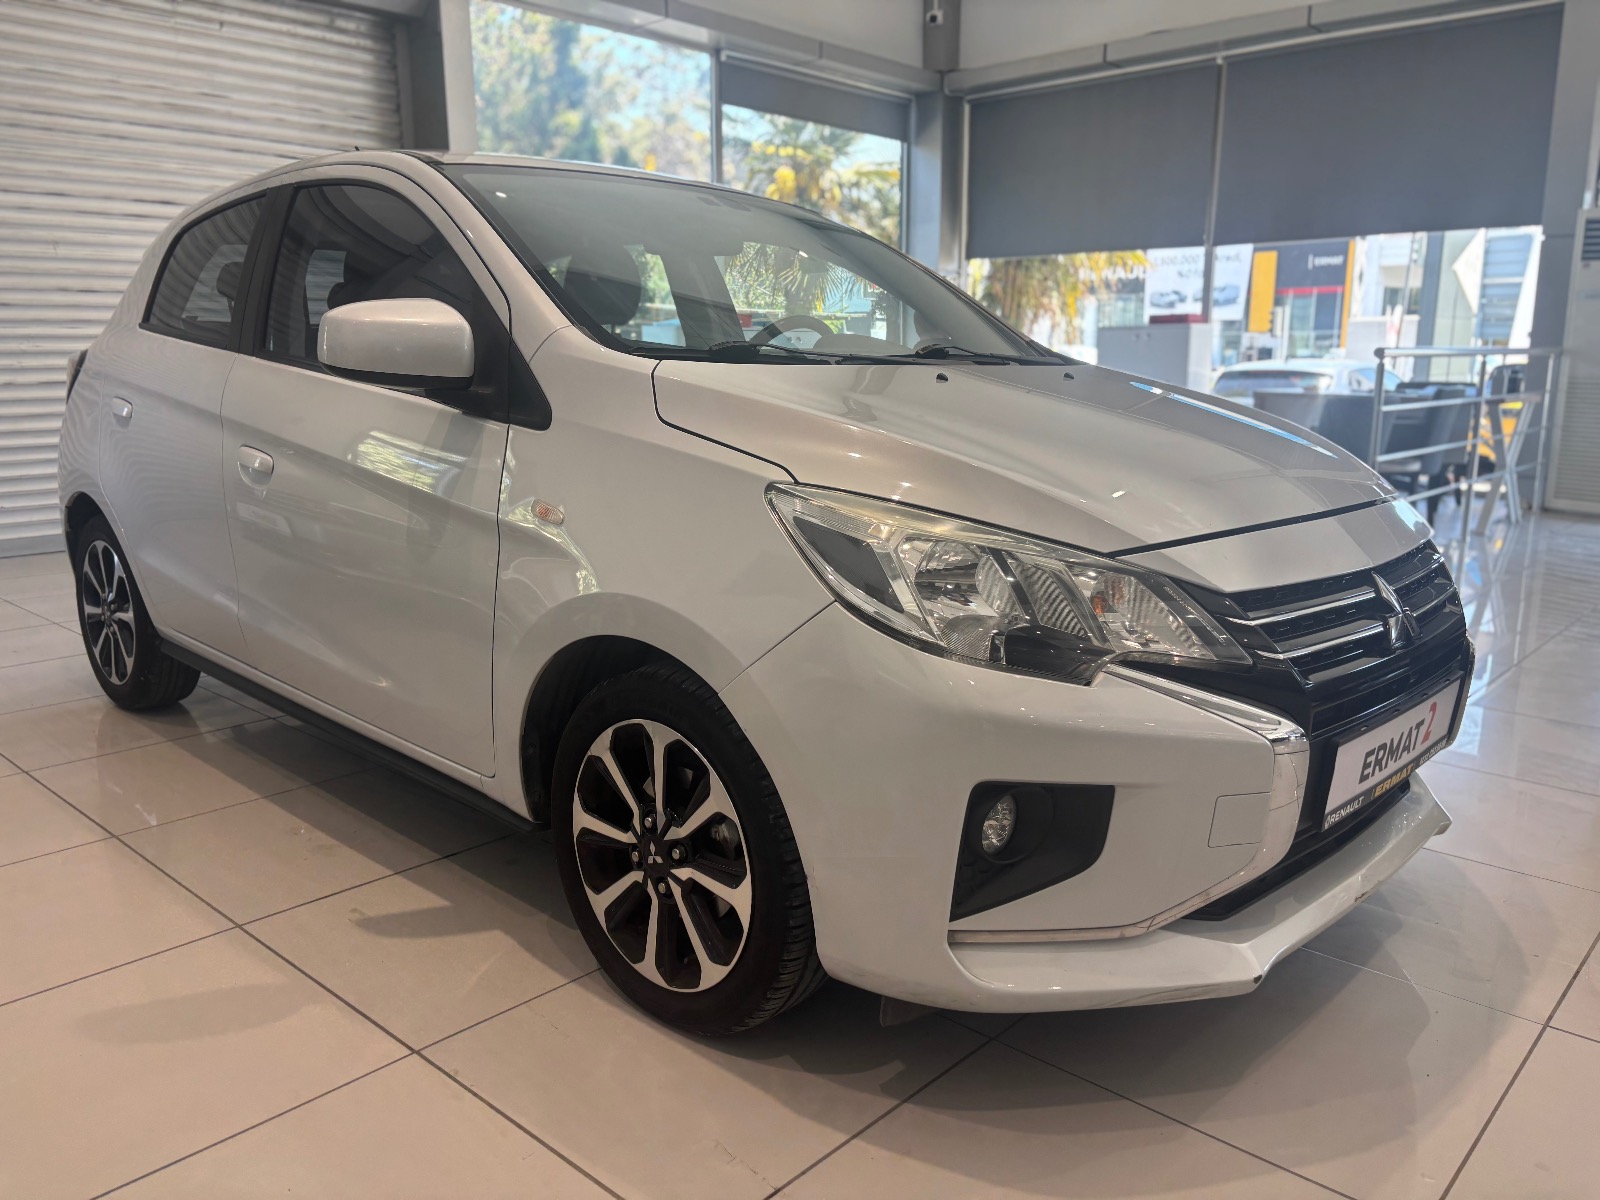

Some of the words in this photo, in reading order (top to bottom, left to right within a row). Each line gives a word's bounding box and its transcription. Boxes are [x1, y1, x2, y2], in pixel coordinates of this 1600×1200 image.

[1358, 719, 1425, 784] ERMAT
[1421, 701, 1437, 745] 2
[1330, 796, 1364, 822] RENAULT
[1375, 763, 1413, 797] ERMAT
